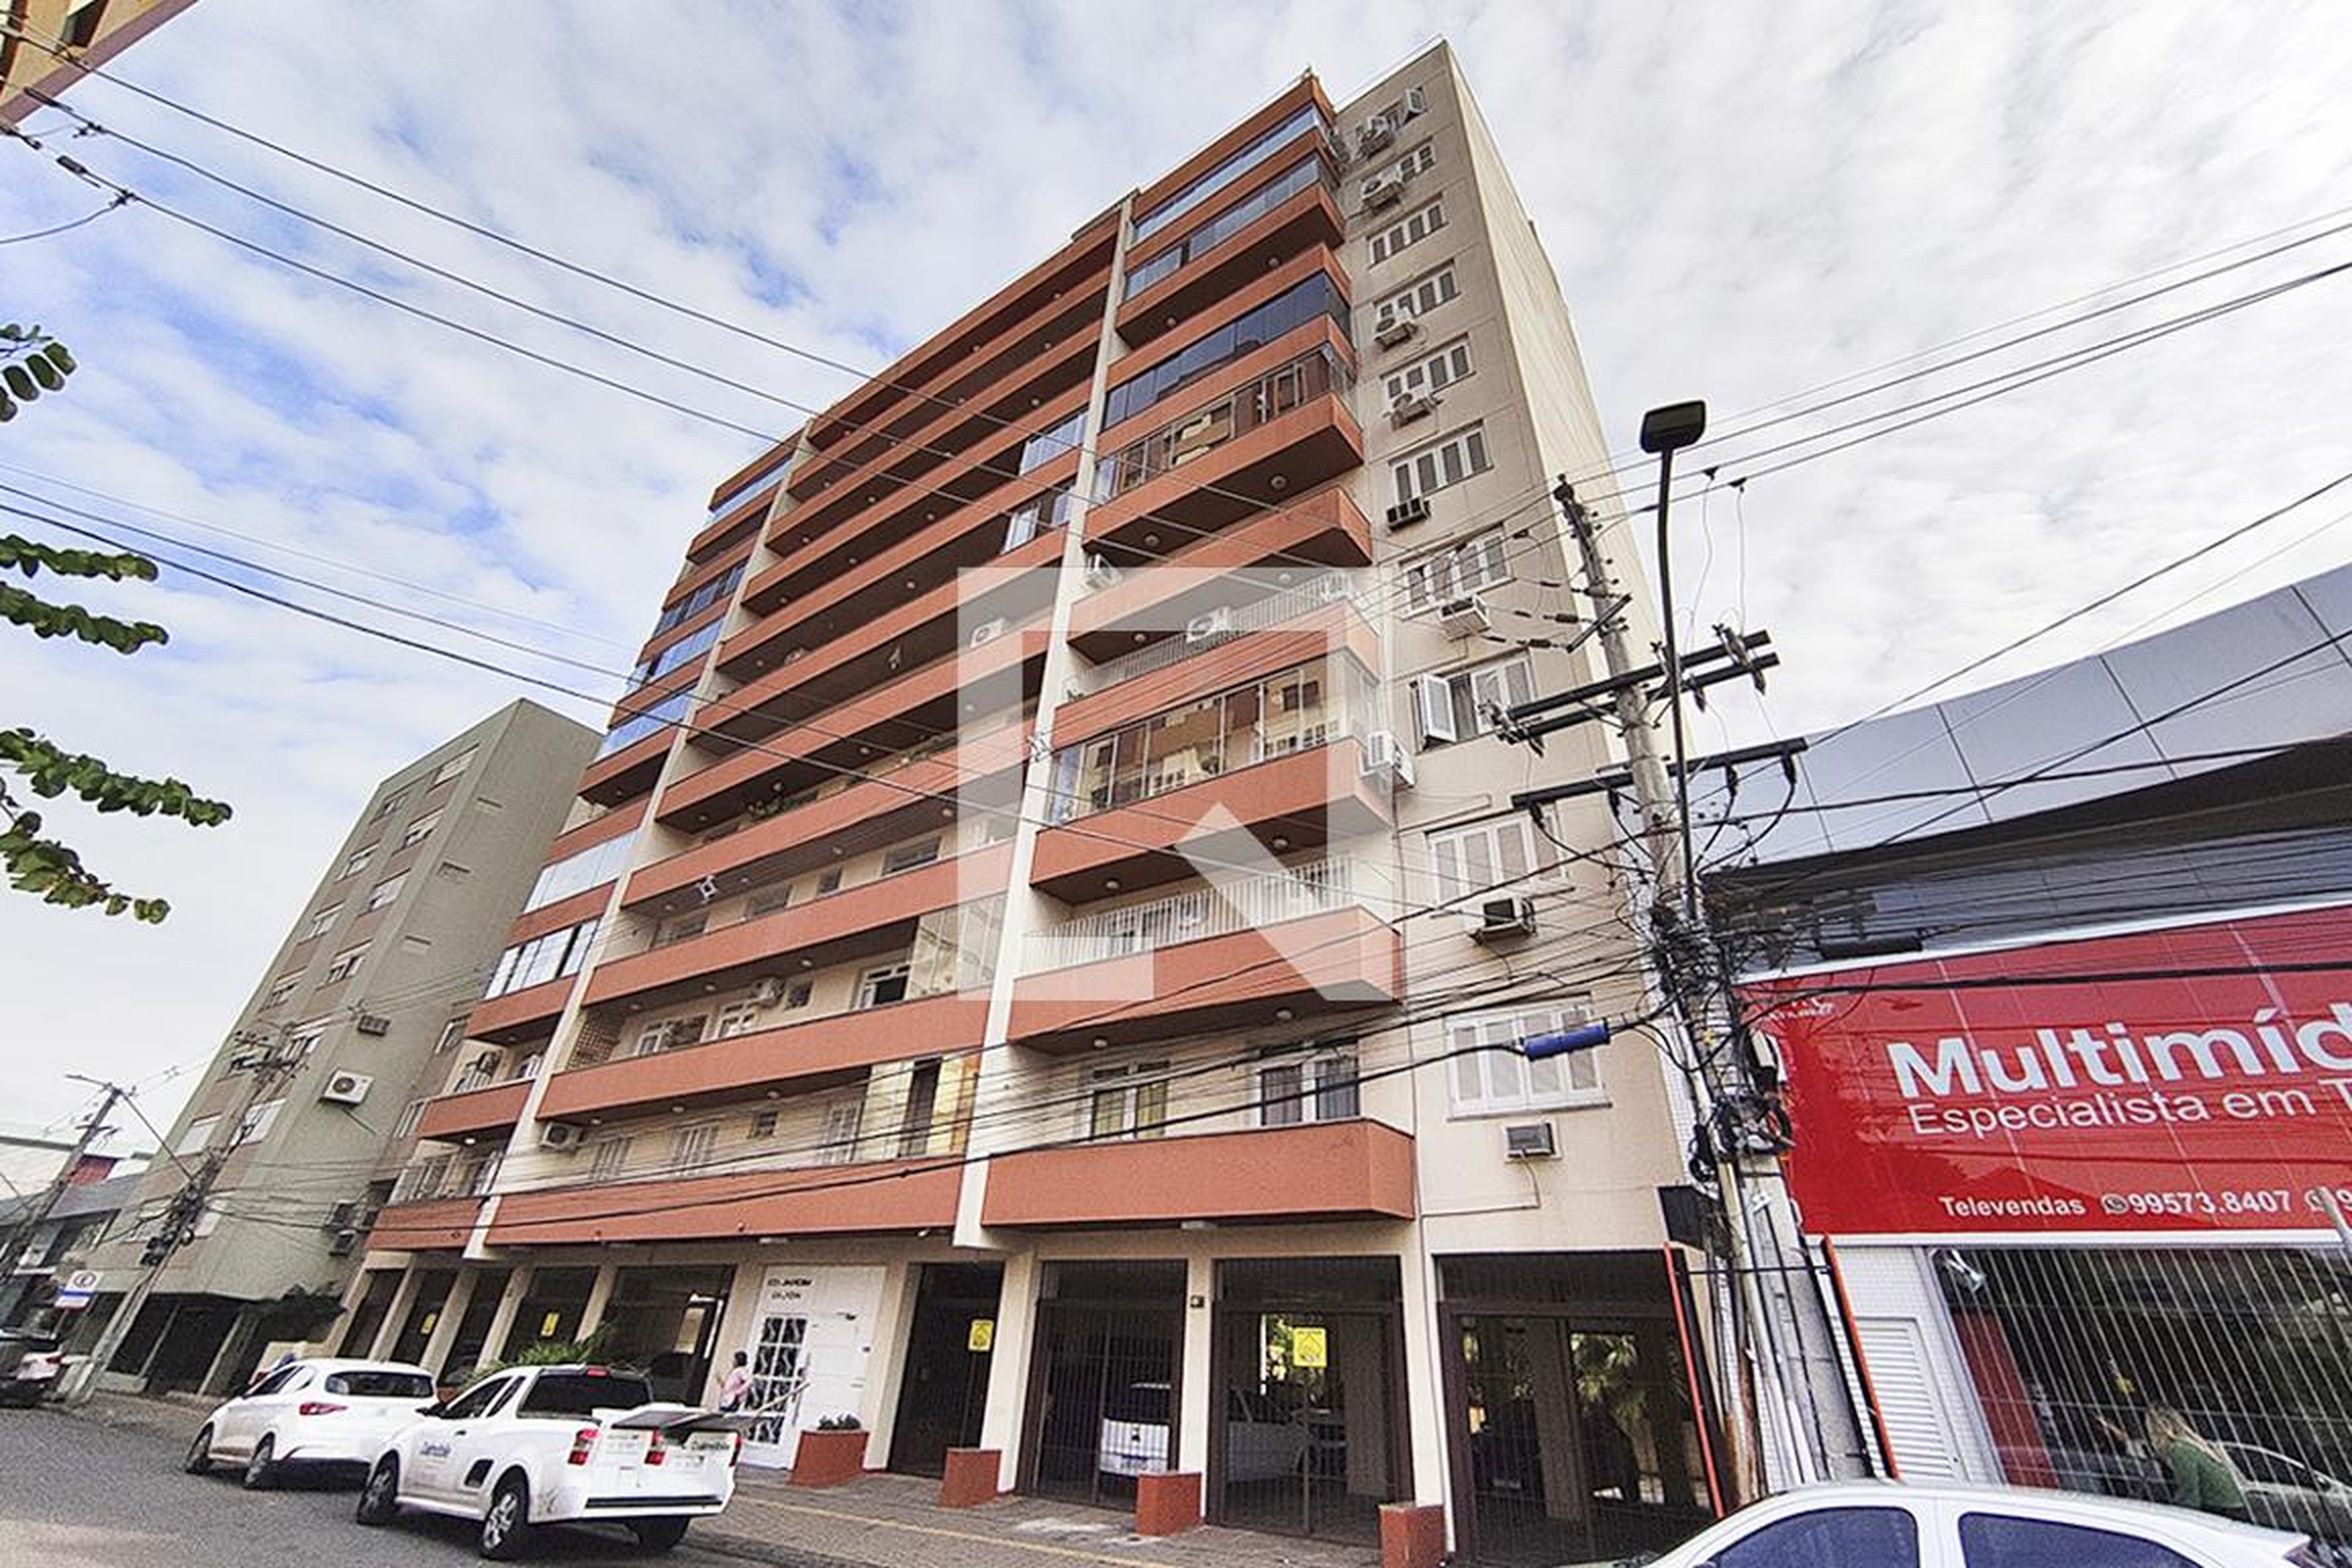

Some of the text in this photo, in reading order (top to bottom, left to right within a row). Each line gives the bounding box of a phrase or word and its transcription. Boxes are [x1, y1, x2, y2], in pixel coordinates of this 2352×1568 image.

[1887, 1003, 2352, 1098] Multimíd
[1907, 1091, 2211, 1139] Especialista
[2222, 1089, 2316, 1118] em
[1939, 1194, 2086, 1216] Televendas
[2128, 1189, 2291, 1215] 99573.8407
